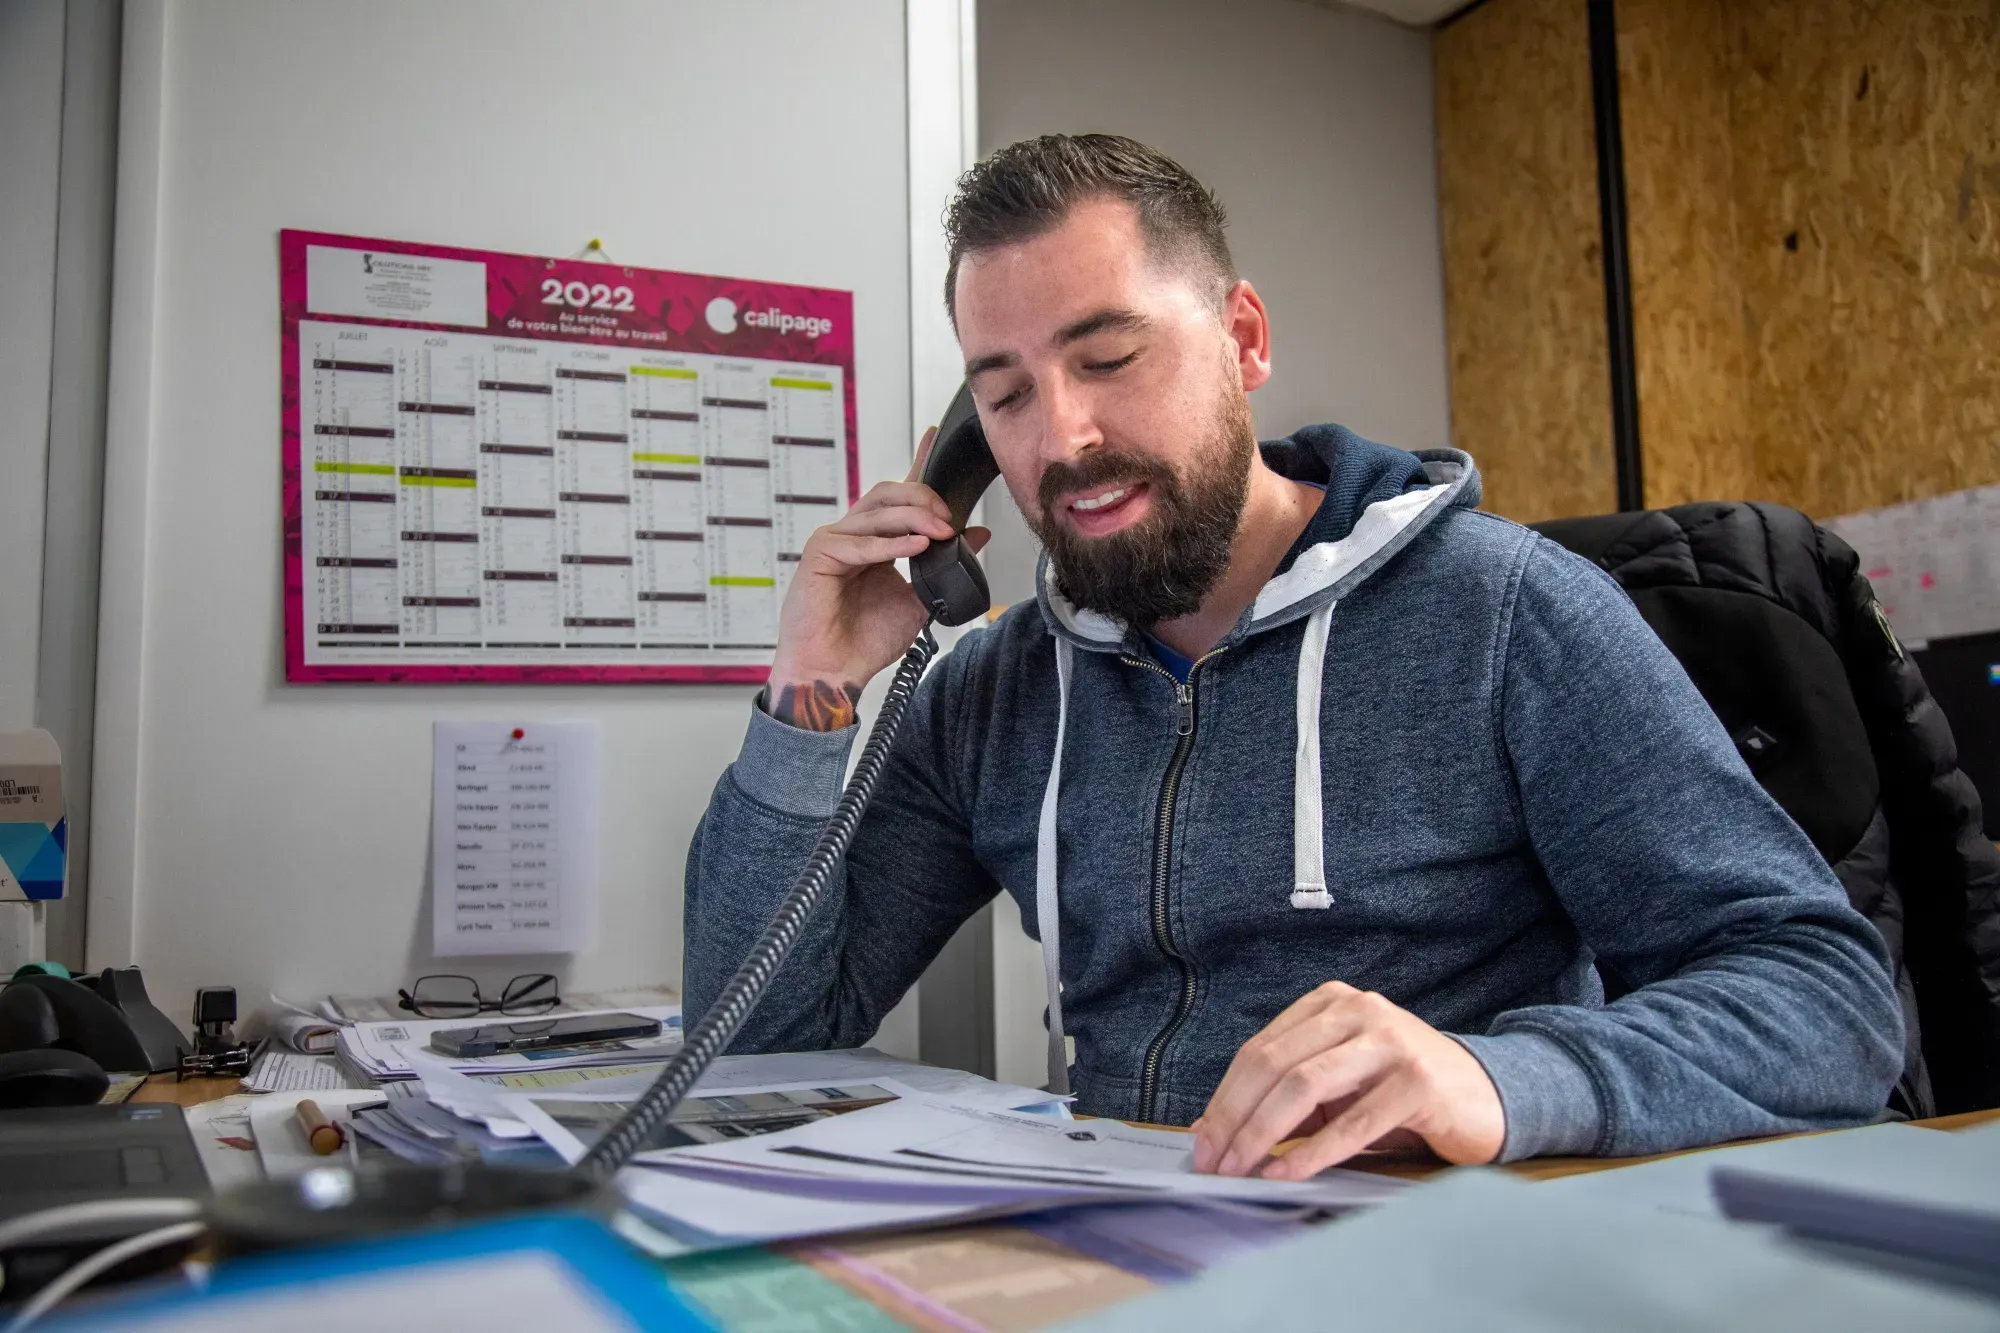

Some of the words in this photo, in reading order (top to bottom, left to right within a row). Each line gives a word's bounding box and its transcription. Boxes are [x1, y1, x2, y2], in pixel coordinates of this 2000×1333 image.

[541, 278, 635, 312] 2022
[507, 317, 523, 329] de
[526, 319, 558, 332] votre
[560, 321, 613, 337] bien-être
[615, 329, 630, 339] au
[632, 329, 668, 342] travail
[559, 311, 575, 322] Au
[577, 313, 618, 326] service
[743, 307, 832, 338] calipage
